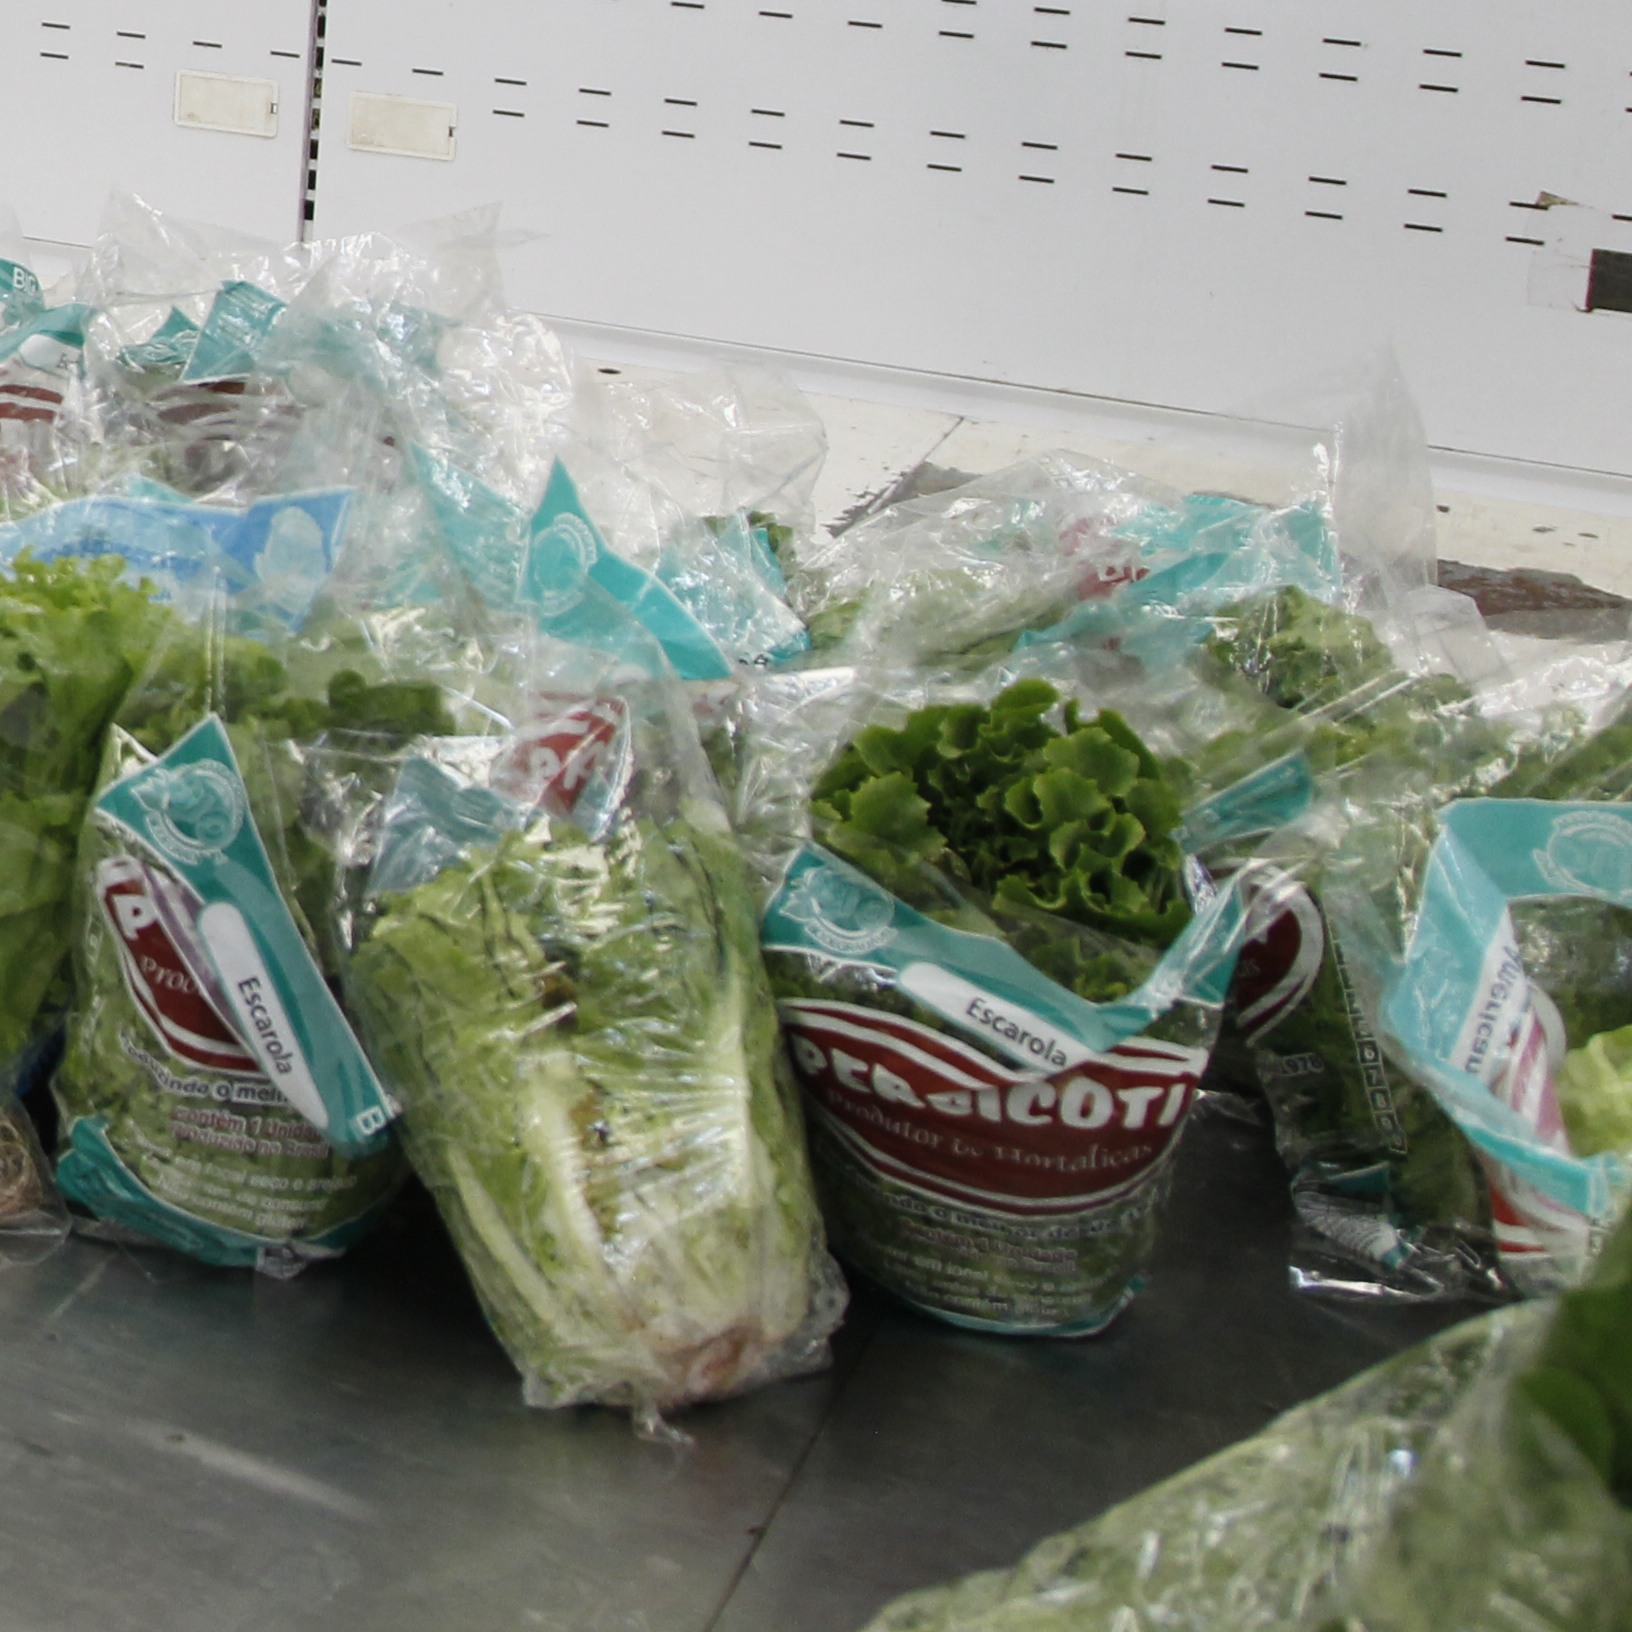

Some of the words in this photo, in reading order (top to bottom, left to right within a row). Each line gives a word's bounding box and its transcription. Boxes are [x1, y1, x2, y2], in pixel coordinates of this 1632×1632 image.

[237, 976, 295, 1077] Escarola
[964, 995, 1068, 1069] Escarola
[215, 1082, 231, 1100] o
